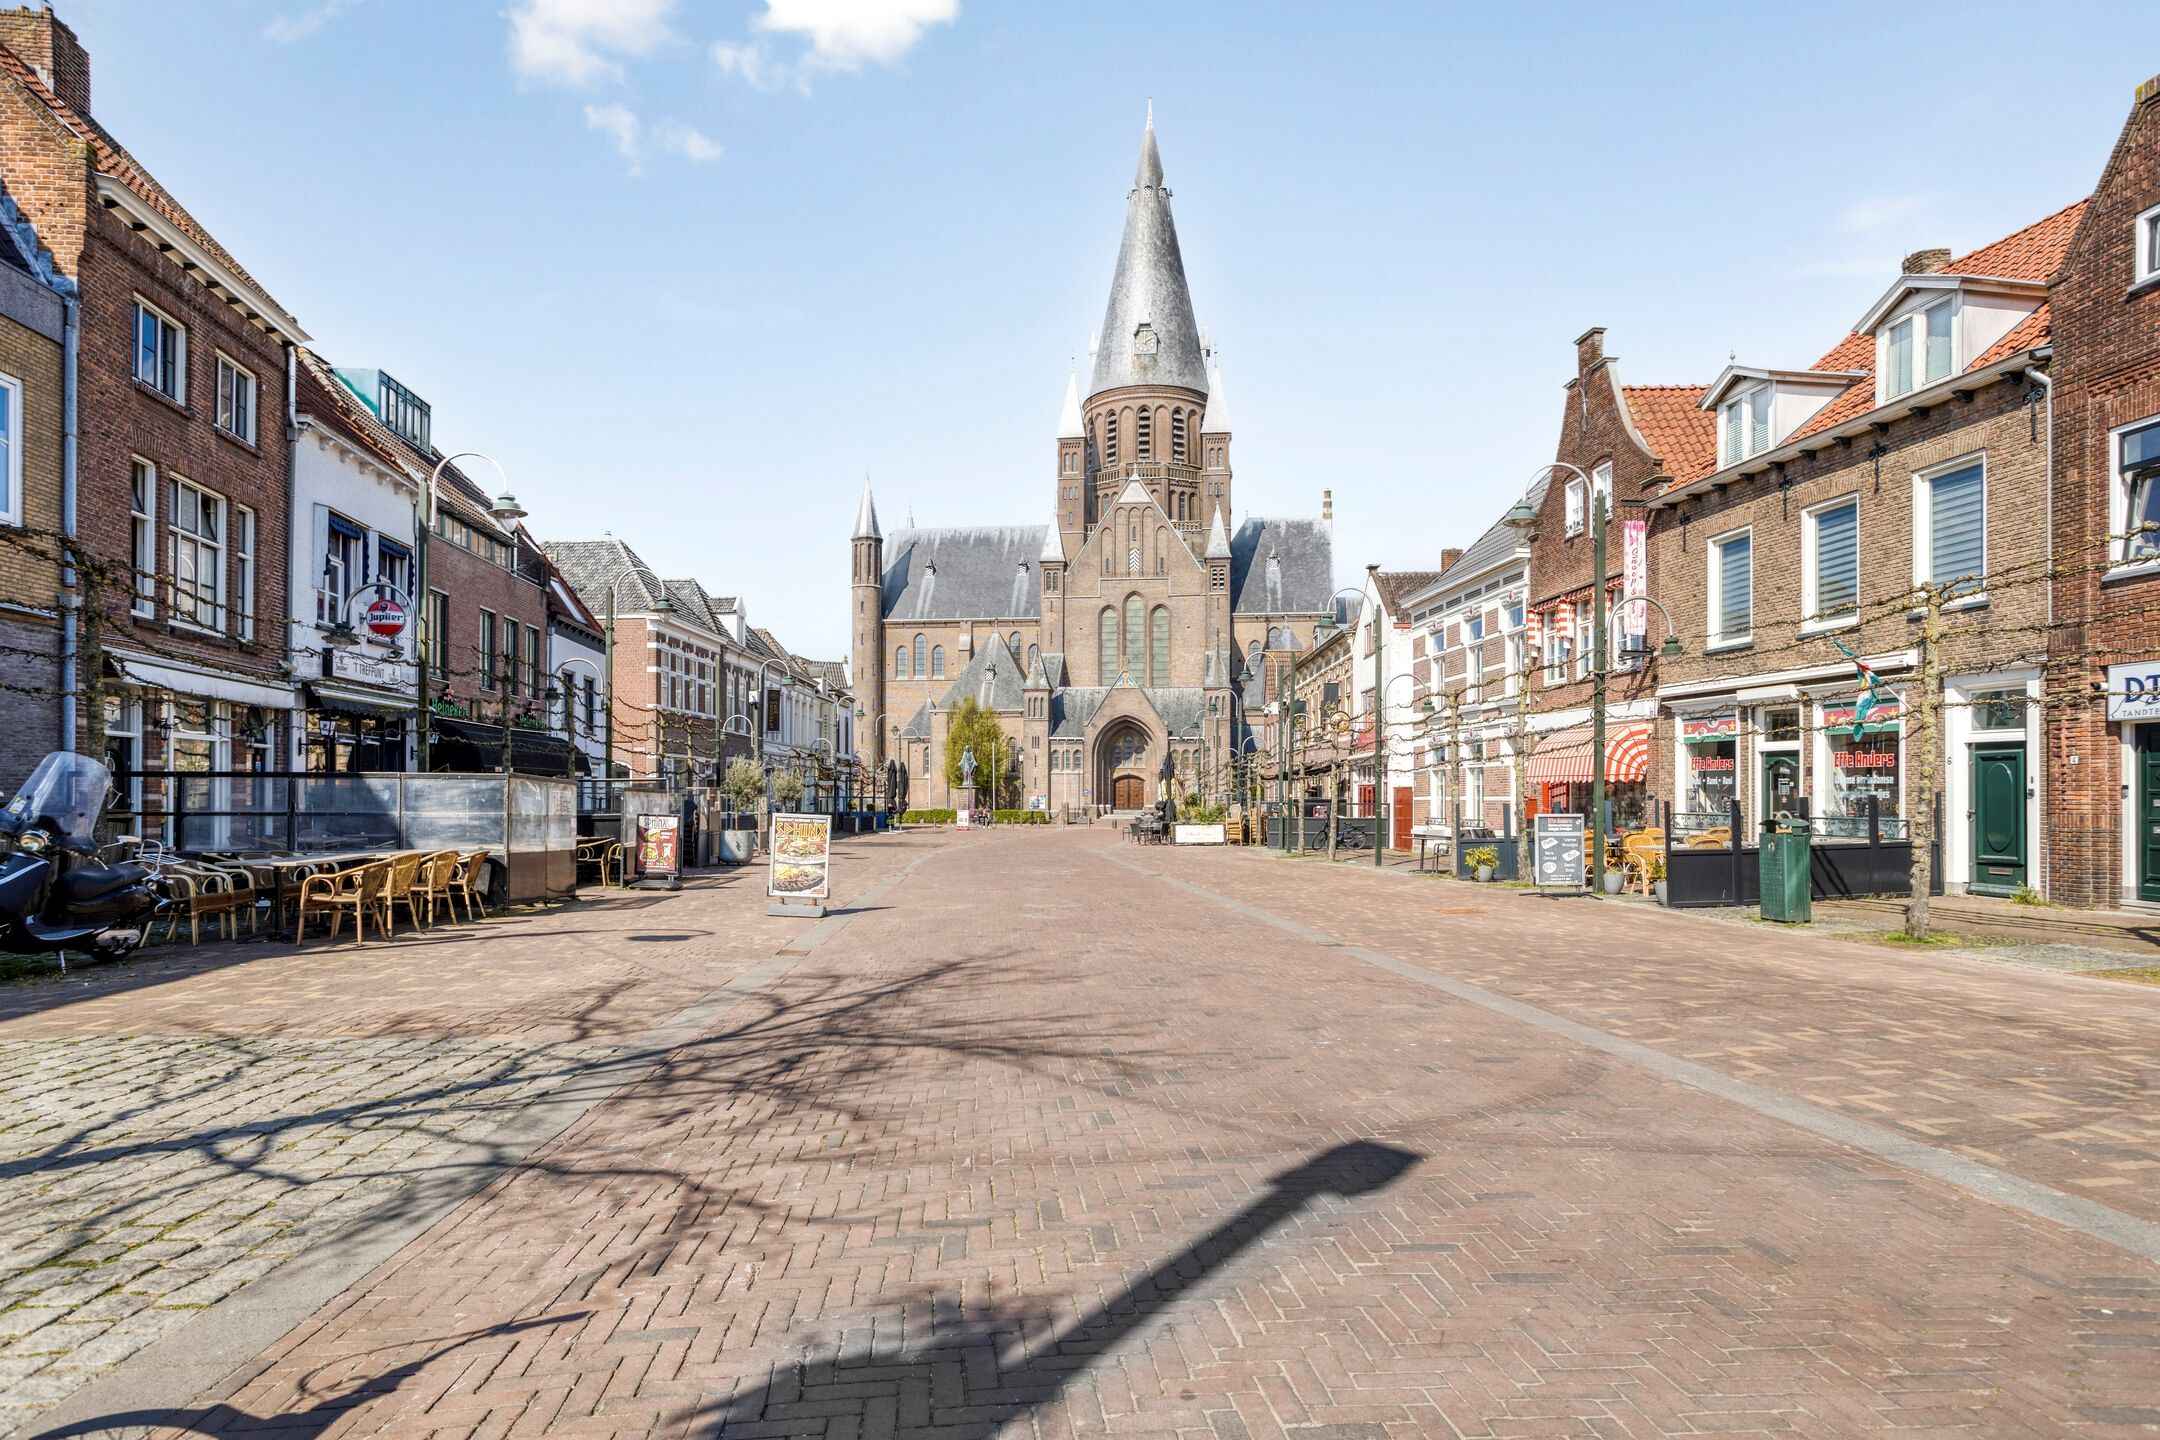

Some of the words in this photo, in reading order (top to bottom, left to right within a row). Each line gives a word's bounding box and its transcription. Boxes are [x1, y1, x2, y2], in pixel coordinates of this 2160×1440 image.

[359, 663, 385, 680] TREFPUNT
[431, 698, 467, 717] Heineken
[1705, 756, 1734, 771] Anders
[1834, 751, 1854, 768] Effe
[1855, 750, 1895, 768] Anders
[1947, 756, 1952, 765] 6
[776, 821, 828, 838] SPHINX
